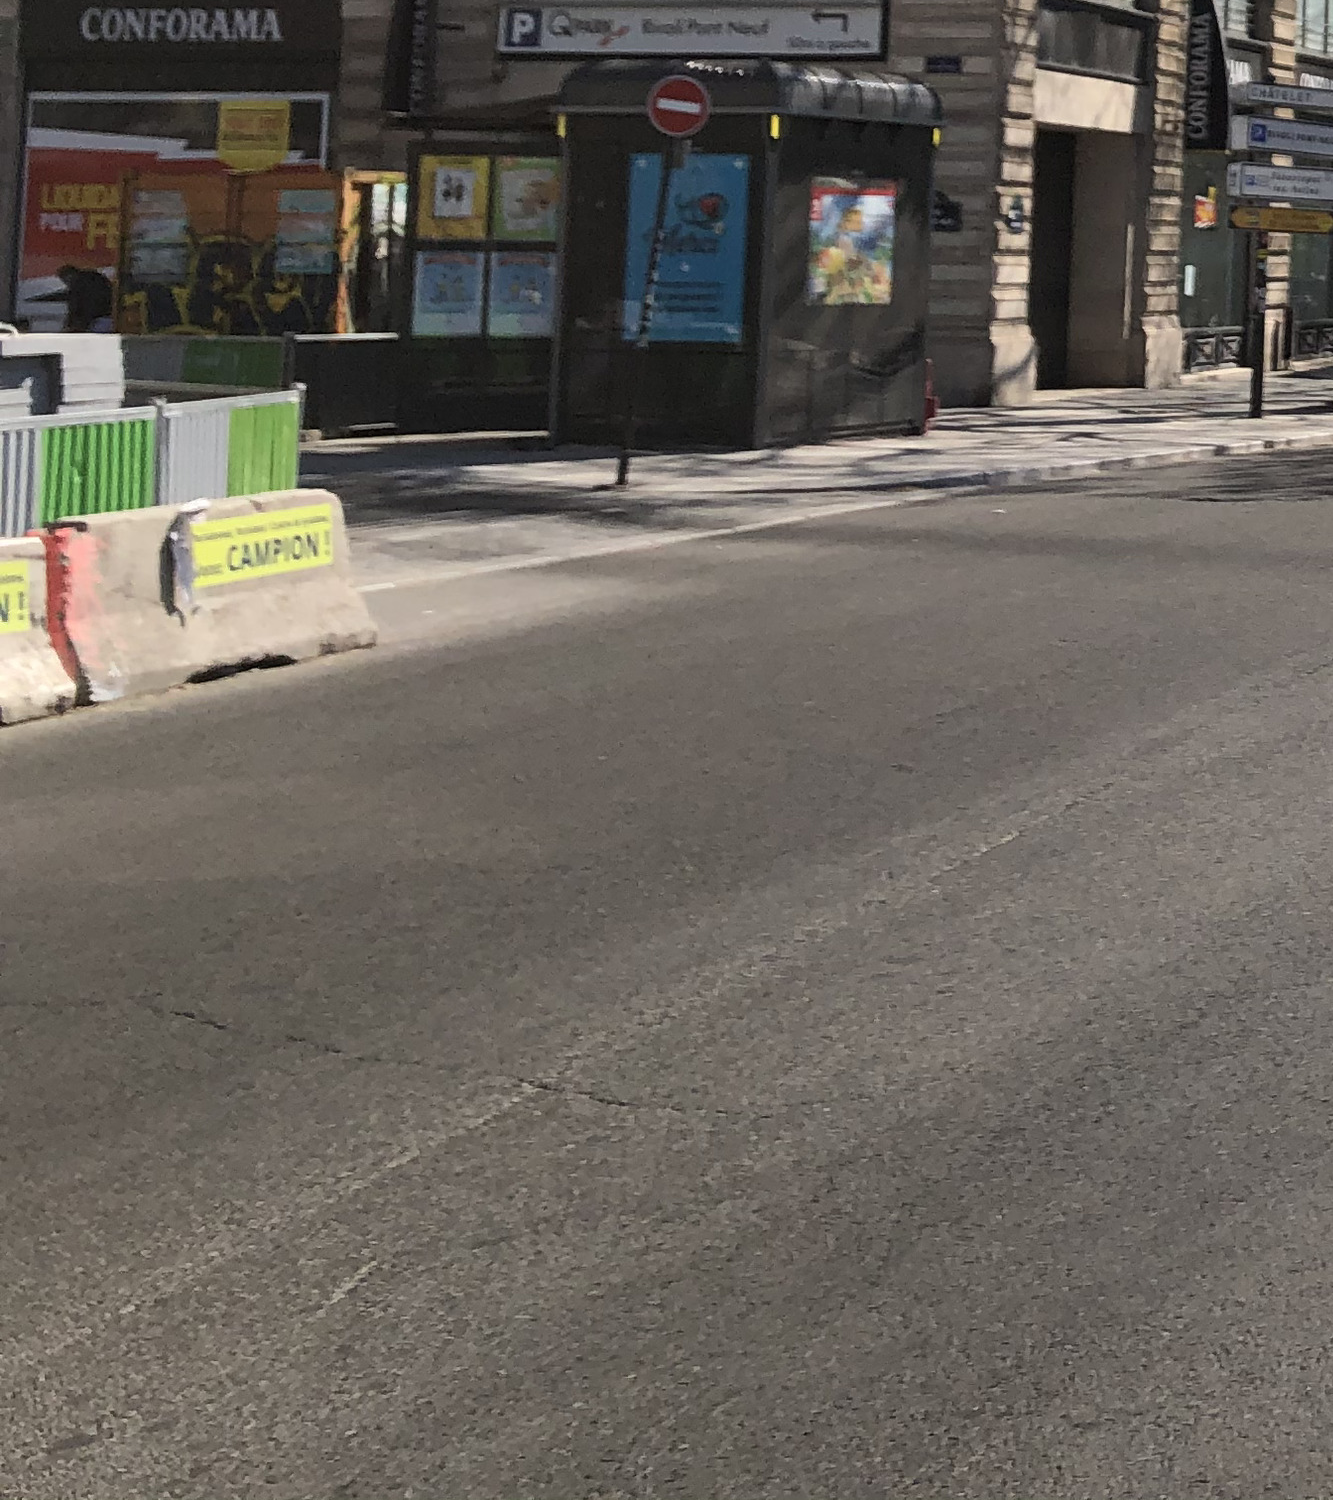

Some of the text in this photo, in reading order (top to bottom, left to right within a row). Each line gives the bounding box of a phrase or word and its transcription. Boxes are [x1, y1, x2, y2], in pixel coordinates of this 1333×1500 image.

[80, 7, 284, 43] CONFORAMA
[511, 12, 535, 43] P
[1187, 12, 1212, 140] CONFORAMA
[1250, 86, 1313, 102] CHÂTELET
[227, 532, 320, 572] CAMPION
